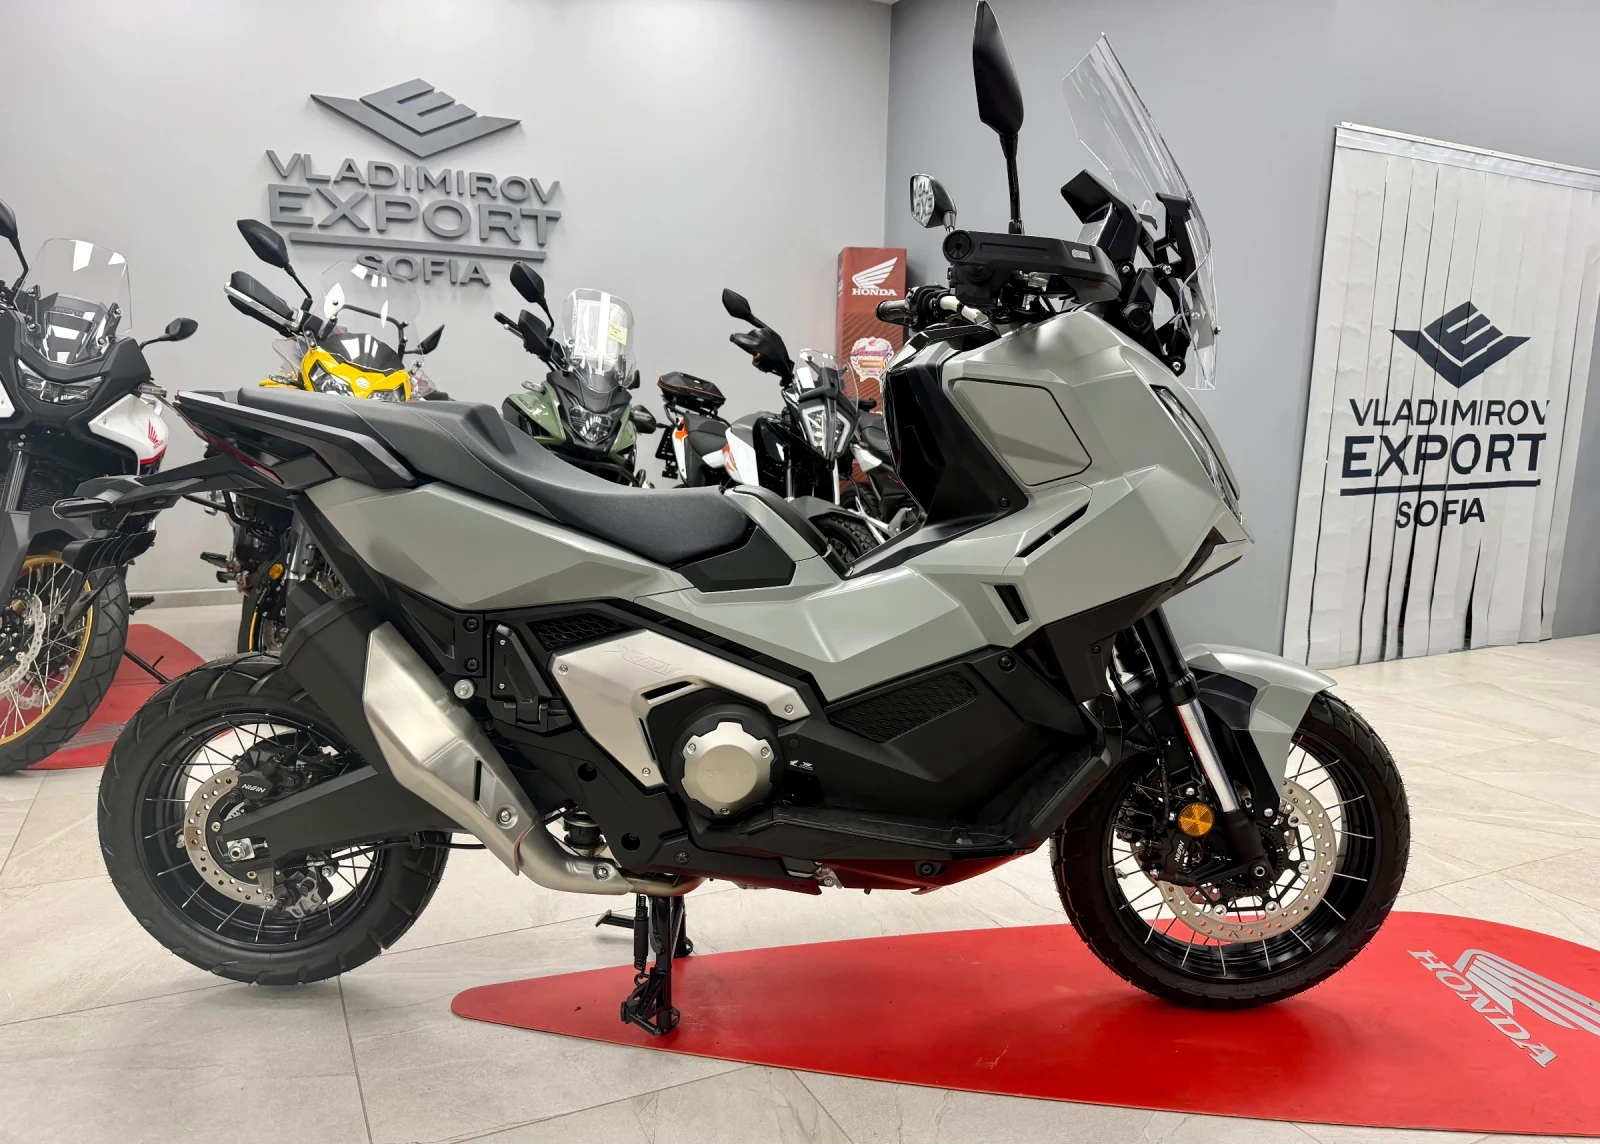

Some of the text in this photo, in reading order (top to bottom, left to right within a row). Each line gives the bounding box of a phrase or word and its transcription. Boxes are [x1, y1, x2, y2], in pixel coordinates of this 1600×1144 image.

[266, 150, 560, 204] VLADIMIROV
[268, 183, 562, 246] EXPORT
[356, 252, 491, 286] SOFIA
[852, 288, 897, 296] HONDA
[1349, 398, 1550, 426] VLADIMIROV
[1341, 433, 1547, 478] EXPORT
[1395, 498, 1485, 528] SOFIA
[1406, 949, 1558, 1068] HONDA
